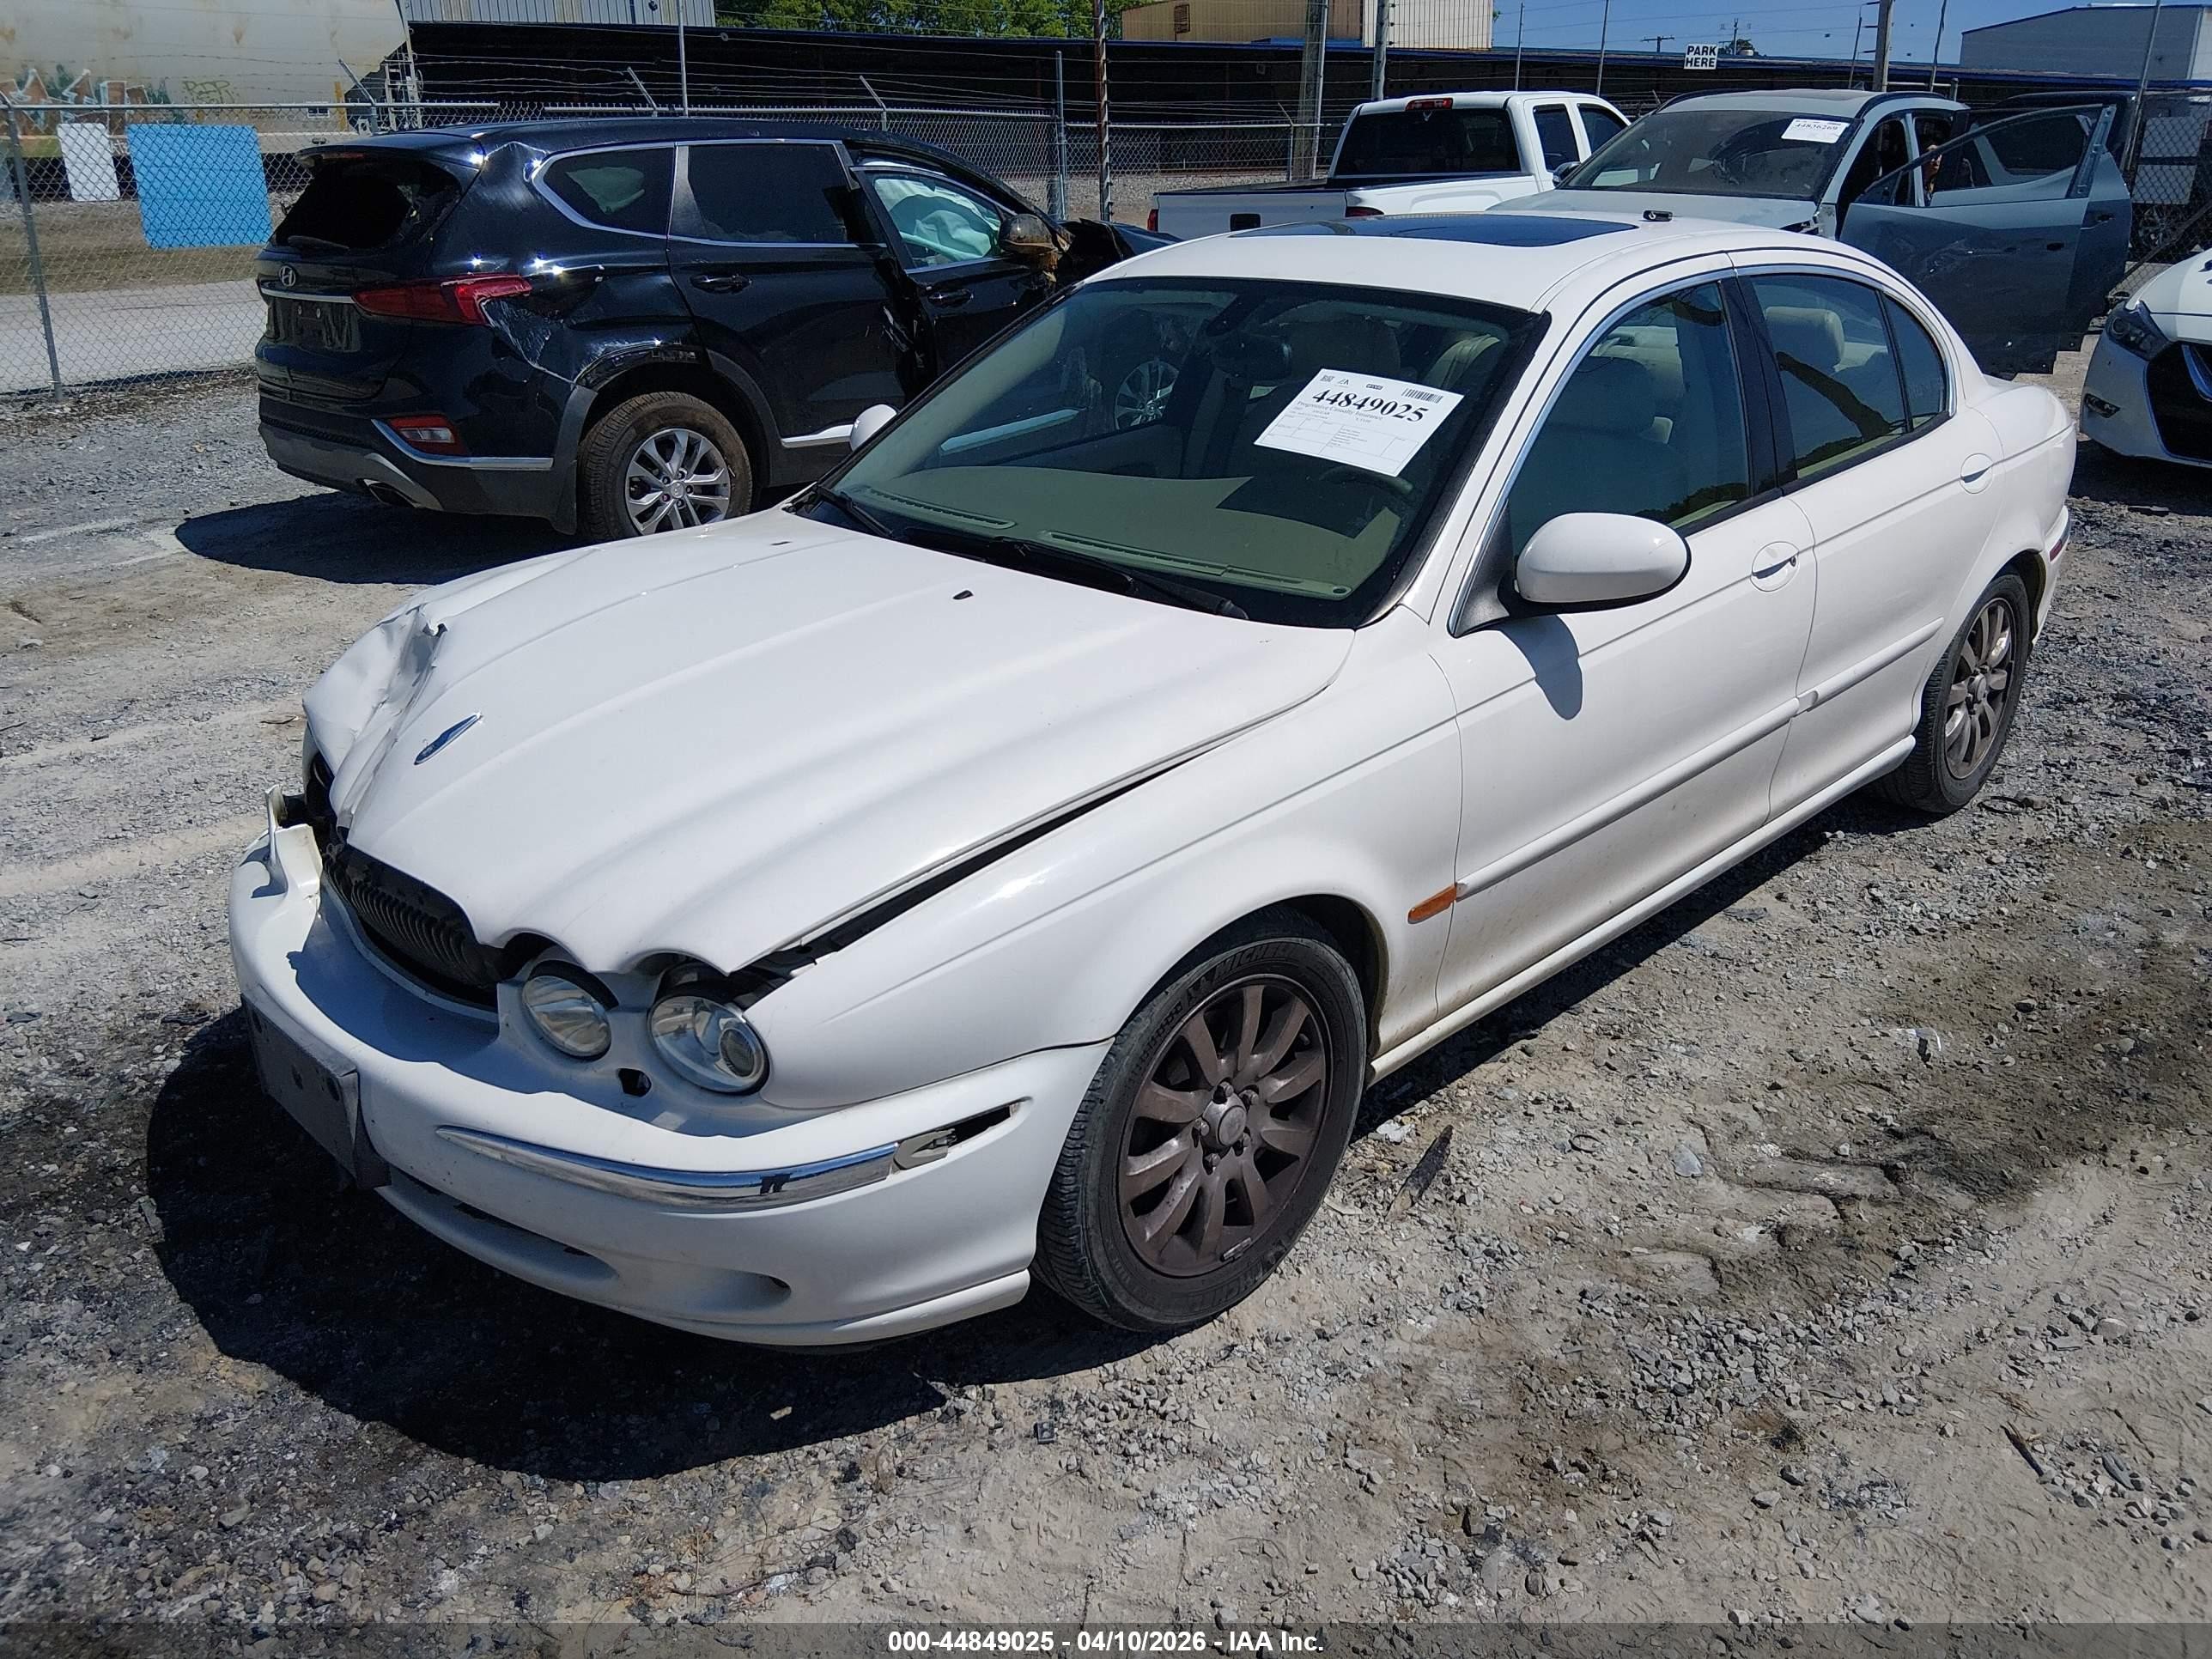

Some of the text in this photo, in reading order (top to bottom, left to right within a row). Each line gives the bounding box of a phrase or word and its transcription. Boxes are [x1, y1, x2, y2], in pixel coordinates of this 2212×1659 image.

[1687, 46, 1717, 56] PARK
[1686, 57, 1716, 67] HERE
[1312, 389, 1430, 422] 44849025
